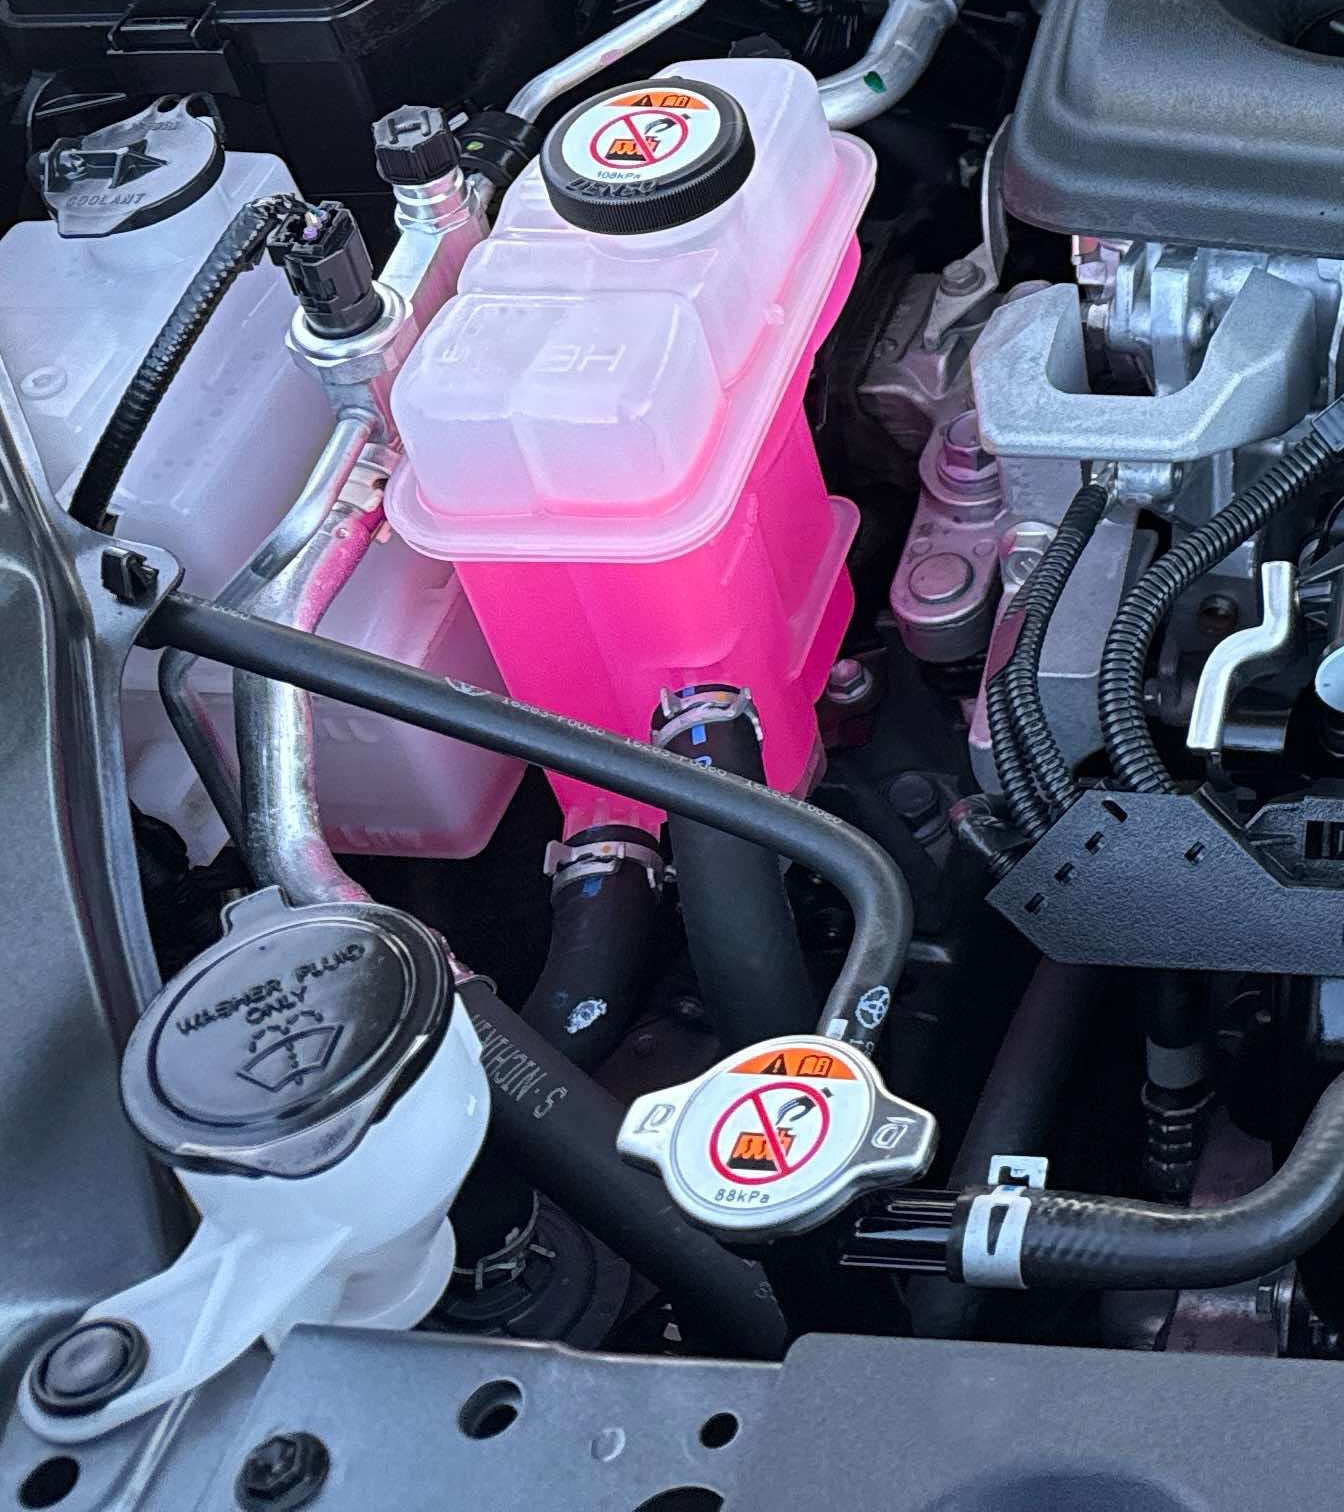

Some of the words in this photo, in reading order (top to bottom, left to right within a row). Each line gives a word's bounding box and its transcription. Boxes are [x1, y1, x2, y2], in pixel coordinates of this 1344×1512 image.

[597, 170, 641, 180] 108kPa
[65, 192, 146, 210] COOLANT
[176, 979, 281, 1036] WASHER
[294, 943, 366, 983] FLUID
[245, 986, 308, 1025] ONLY
[714, 1188, 771, 1205] 88kPa
